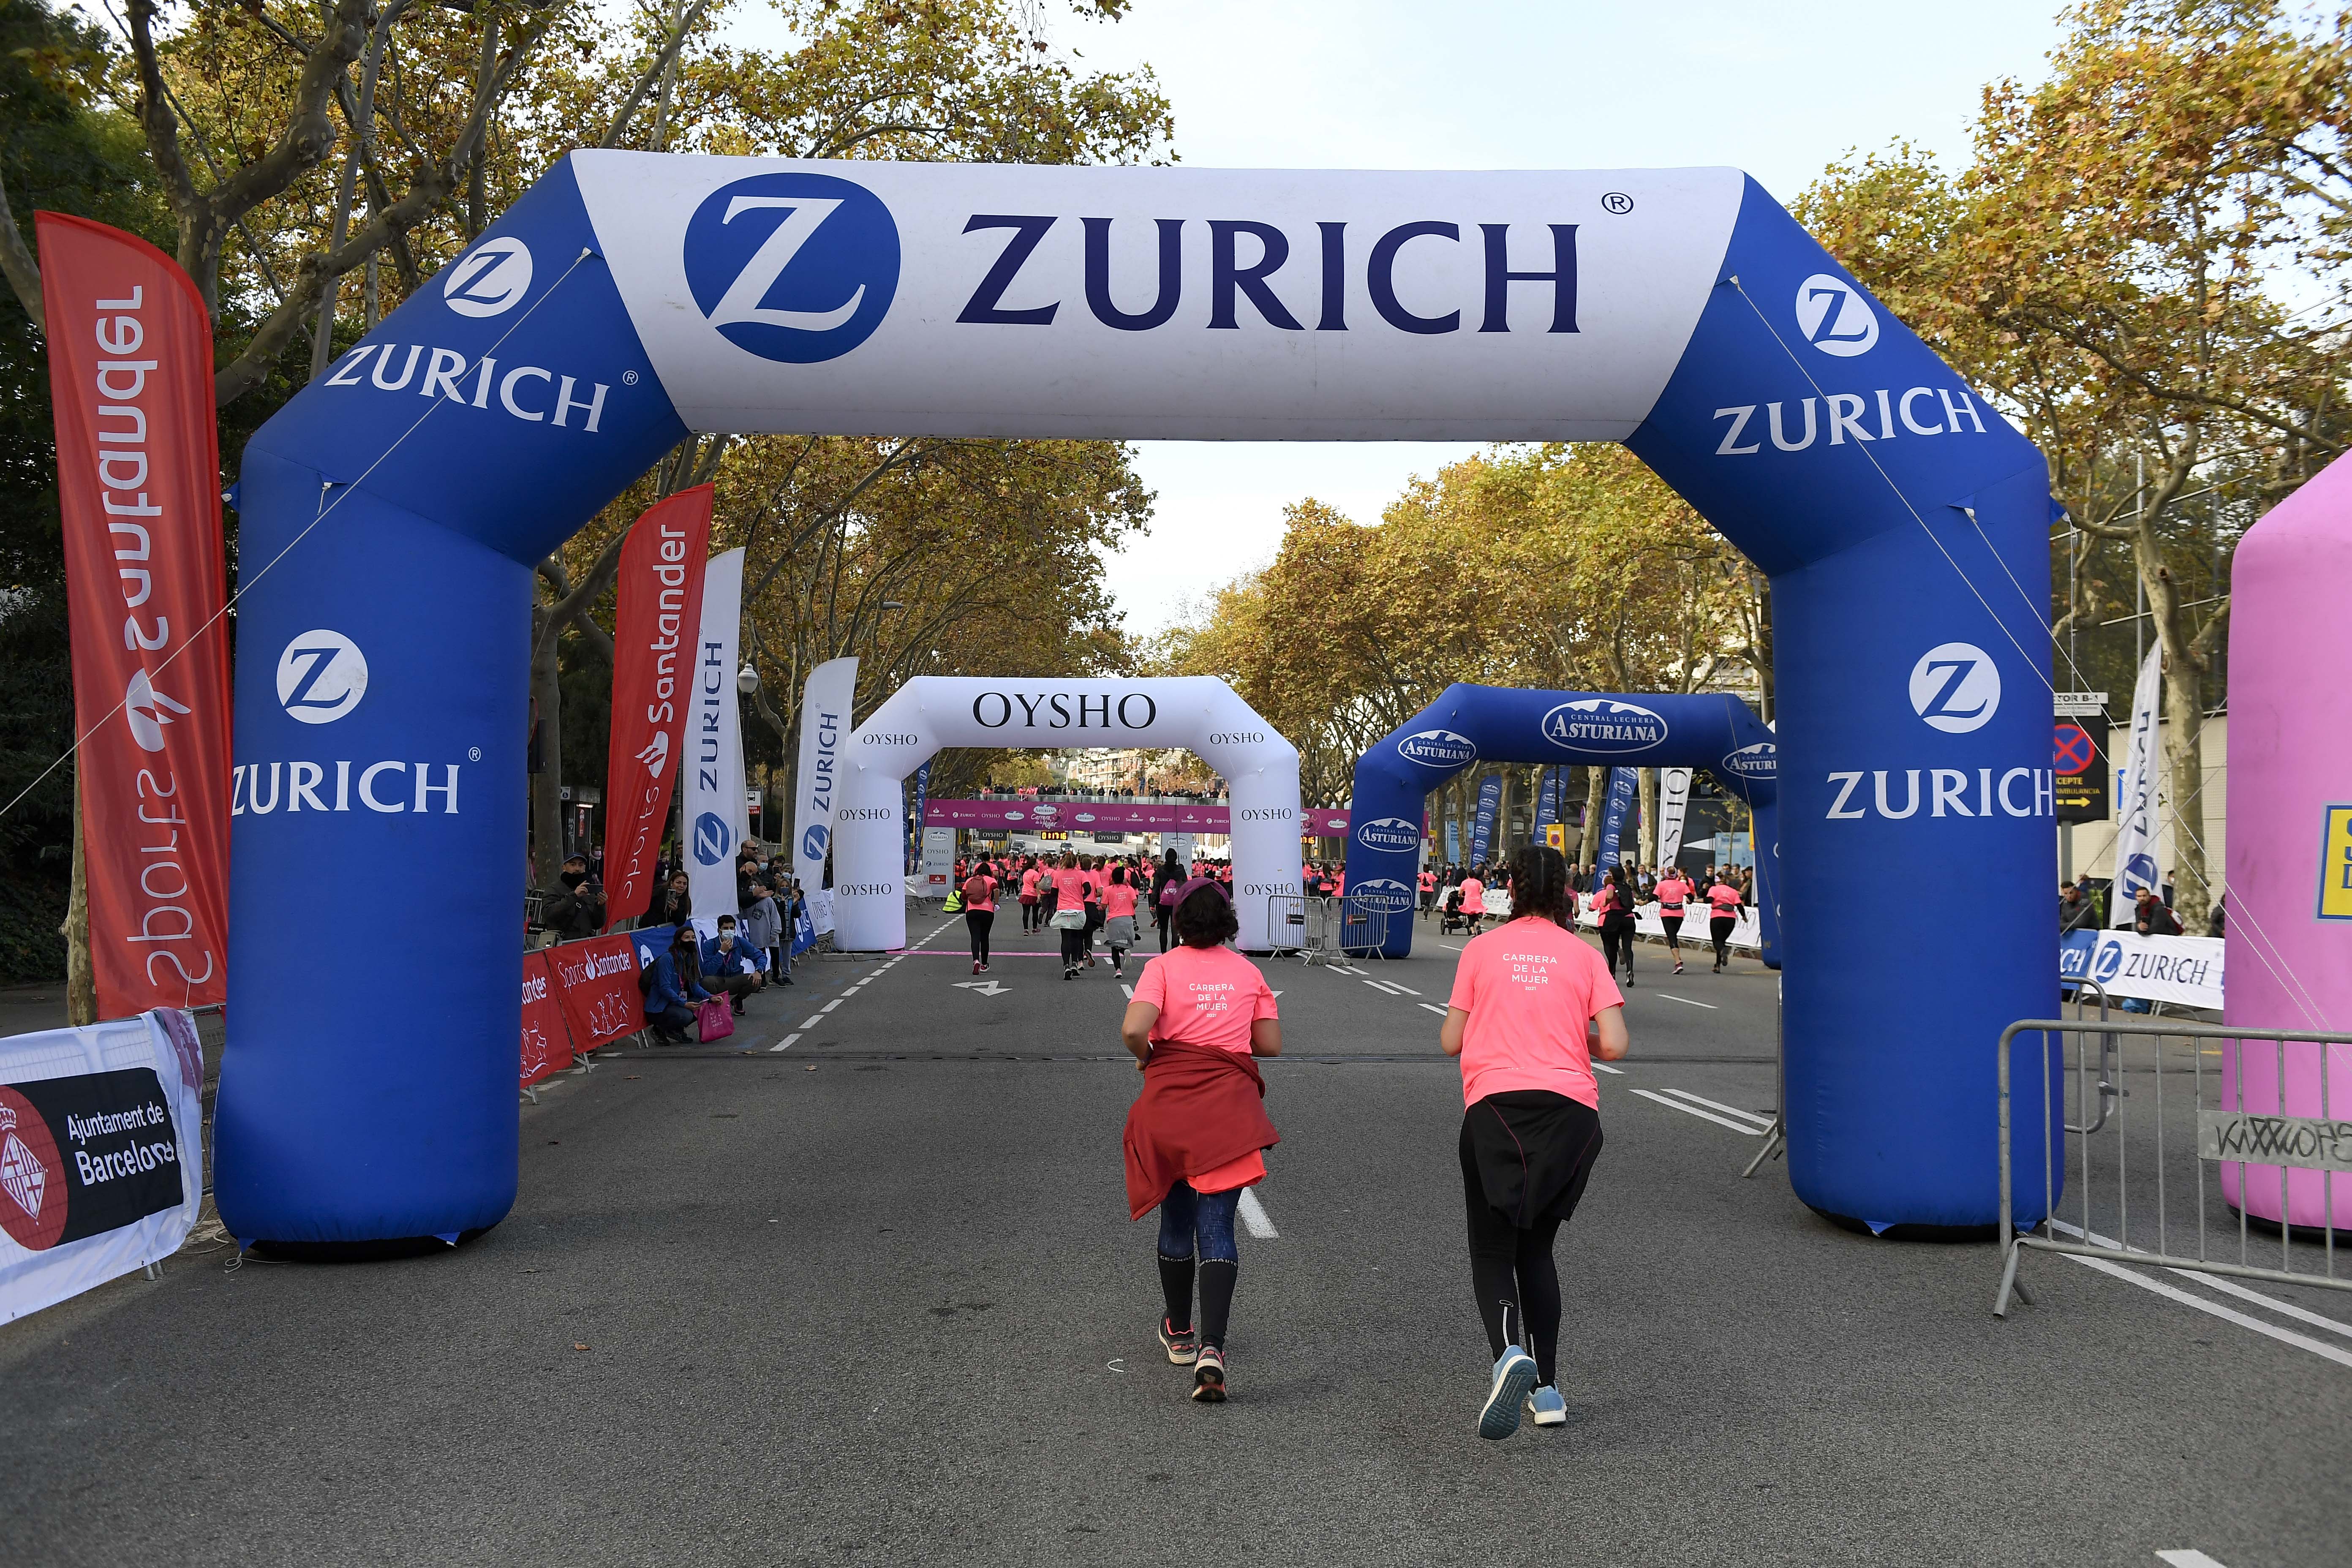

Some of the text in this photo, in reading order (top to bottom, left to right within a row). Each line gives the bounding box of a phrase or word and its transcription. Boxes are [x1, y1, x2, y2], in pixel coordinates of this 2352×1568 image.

[955, 214, 1581, 334] ZURICH
[323, 343, 610, 433] ZURICH
[1712, 387, 1987, 455] ZURICH
[648, 524, 686, 723] Santander
[699, 641, 723, 793] ZURICH
[972, 692, 1156, 729] OYSHO
[863, 733, 918, 746] OYSHO
[1210, 732, 1264, 745] OYSHO
[1550, 714, 1658, 741] ASTURIANA
[812, 712, 838, 813] ZURICH
[1404, 741, 1470, 760] ASTURIANA
[1729, 757, 1776, 770] ASTURI
[231, 760, 460, 816] ZURICH
[1825, 767, 2054, 819] ZURICH
[839, 808, 890, 821] OYSHO
[1241, 808, 1292, 821] OYSHO
[1361, 828, 1416, 845] ASTURIANA
[841, 883, 892, 896] OYSHO
[1244, 883, 1295, 896] OYSHO
[558, 948, 632, 994] Sports Santander
[1503, 953, 1557, 964] CARRERA
[1514, 964, 1546, 974] DE LA
[2124, 953, 2210, 985] ZURICH
[1189, 983, 1235, 991] CARRERA
[1511, 975, 1548, 984] MUJER
[68, 1101, 165, 1146] Ajuntament de
[74, 1139, 176, 1186] Barcelona
